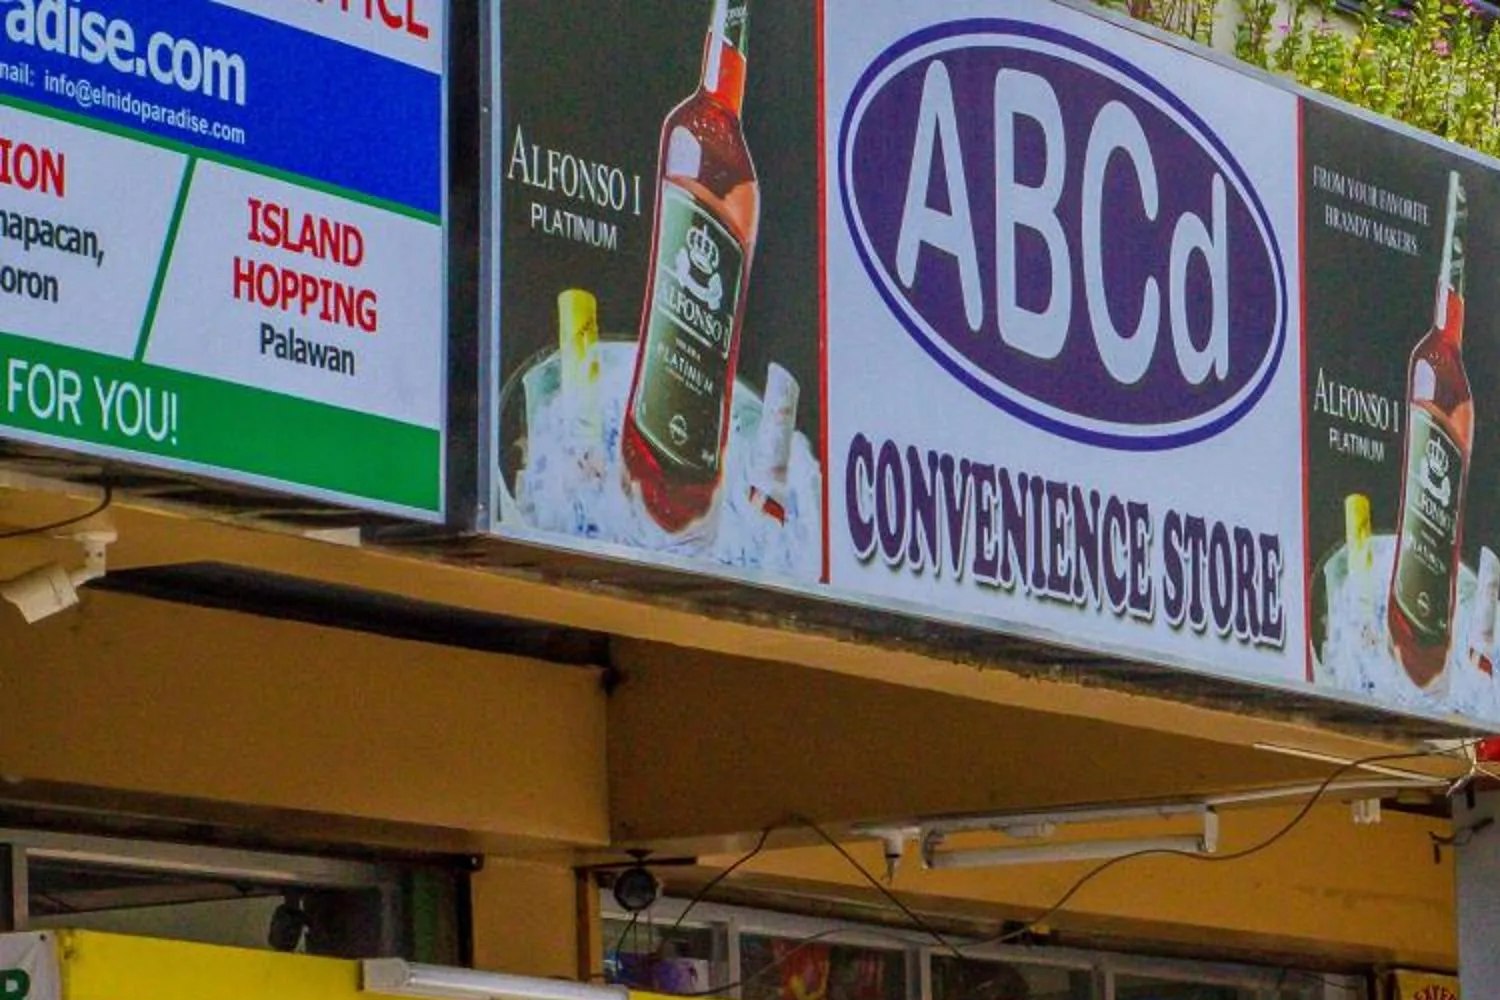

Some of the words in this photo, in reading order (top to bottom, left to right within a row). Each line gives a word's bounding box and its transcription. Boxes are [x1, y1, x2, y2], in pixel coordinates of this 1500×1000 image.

[44, 69, 246, 145] info@elnidoparadise.com
[508, 124, 628, 213] ALFONSO
[1313, 165, 1345, 197] FROM
[1347, 178, 1378, 209] YOUR
[1378, 190, 1431, 226] FAVORITE
[247, 197, 364, 268] ISLAND
[530, 202, 617, 252] PLATINUM
[895, 59, 1229, 387] ABCd
[1325, 204, 1371, 239] BRANDY
[0, 267, 59, 303] oron
[233, 256, 377, 333] HOPPING
[260, 322, 356, 376] Palawan
[8, 358, 83, 427] FOR
[93, 374, 178, 446] YOU!
[1314, 367, 1389, 431] ALFONSO
[1329, 428, 1384, 462] PLATINUM
[845, 432, 1155, 614] CONVENIENCE
[1162, 508, 1286, 647] STORE
